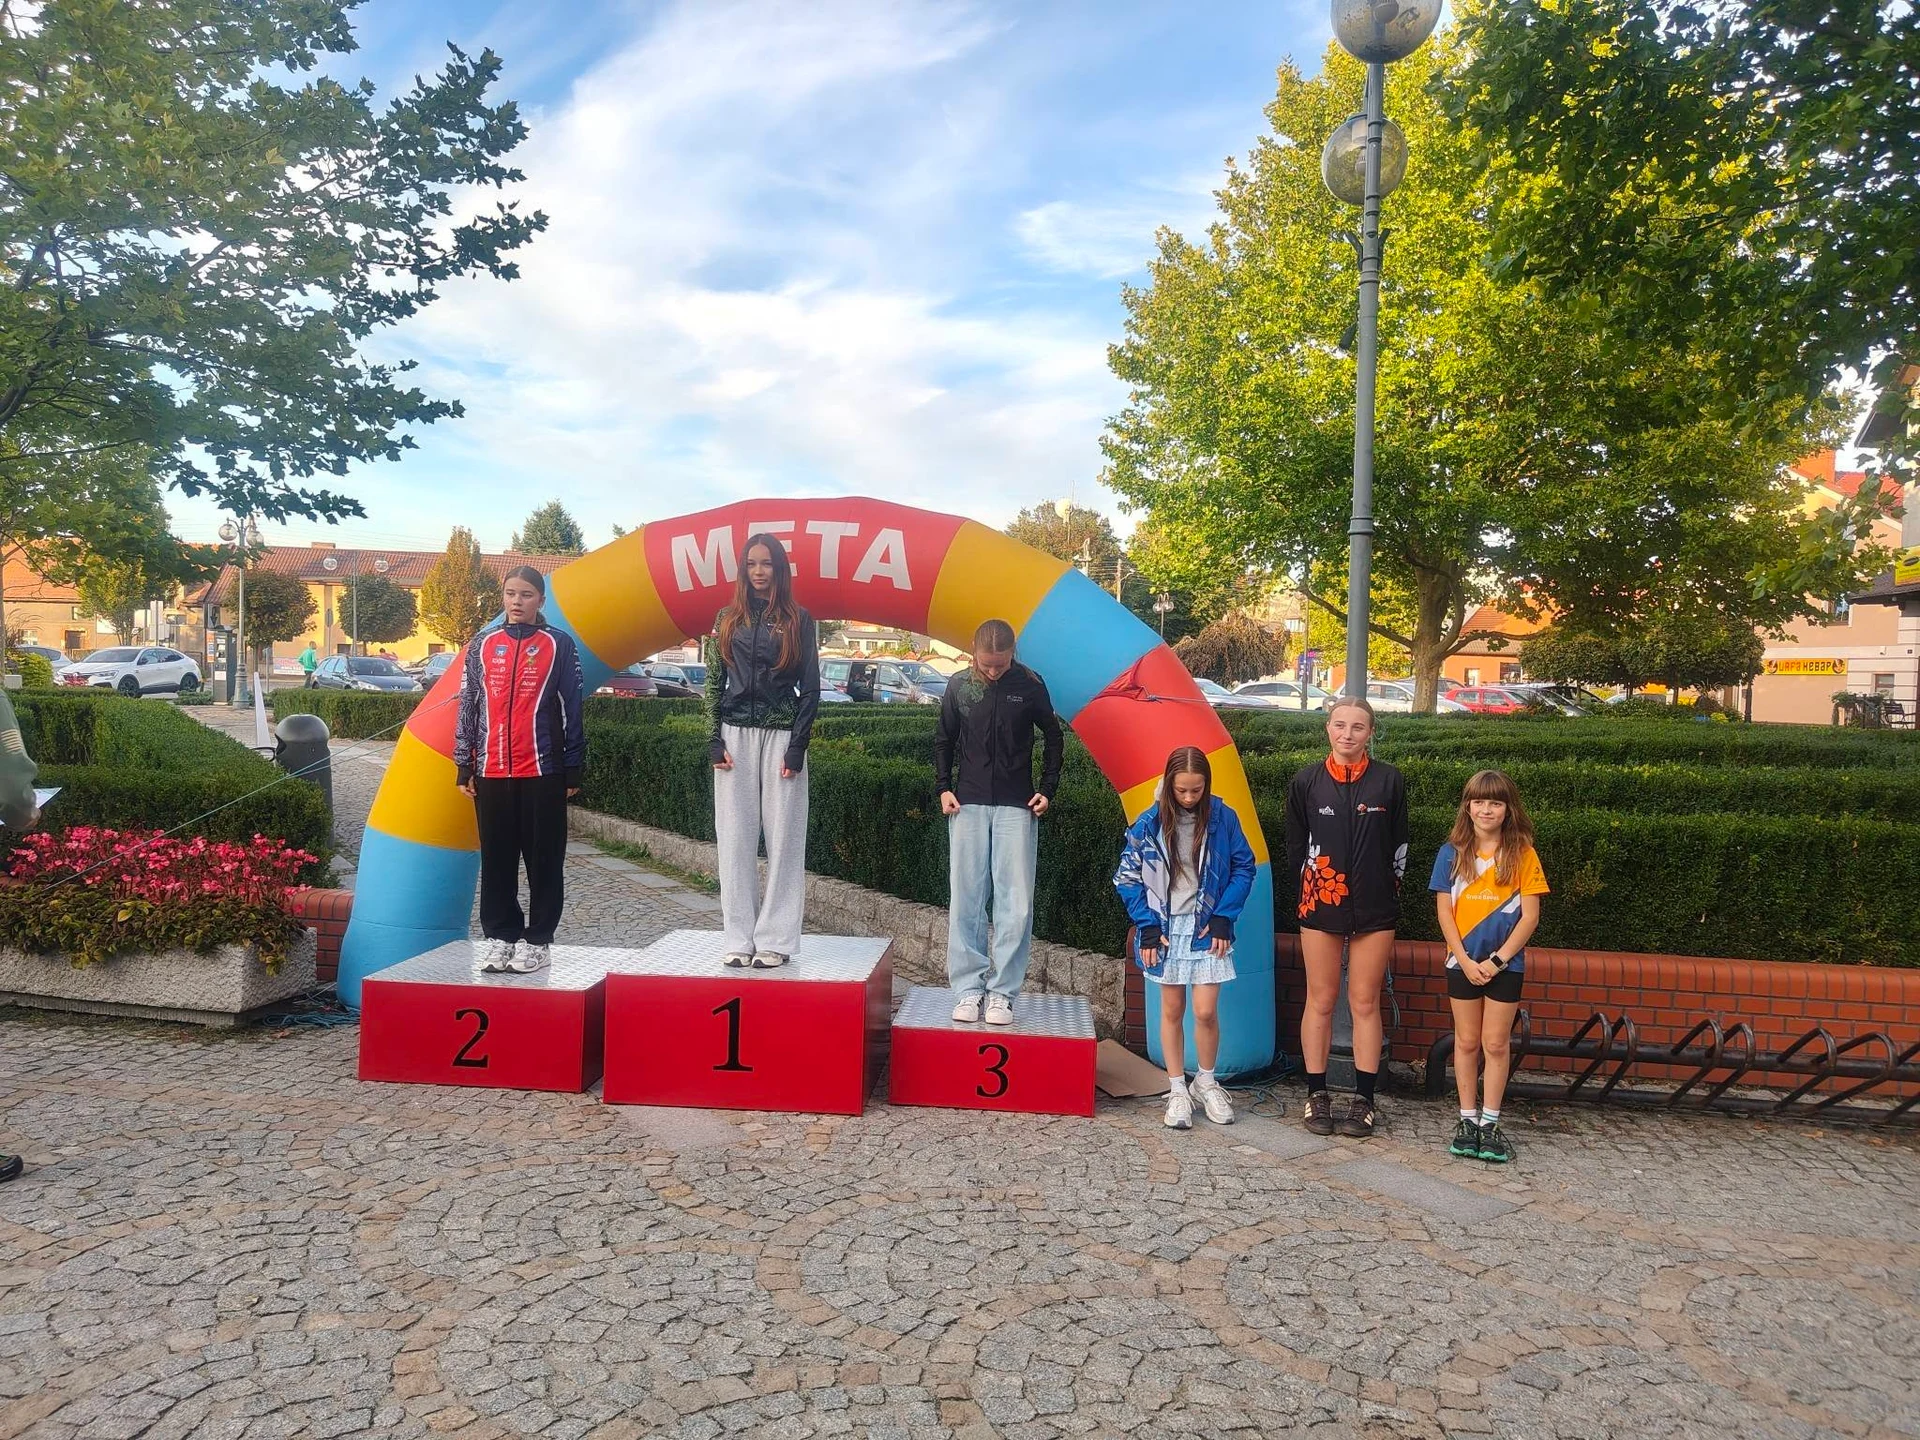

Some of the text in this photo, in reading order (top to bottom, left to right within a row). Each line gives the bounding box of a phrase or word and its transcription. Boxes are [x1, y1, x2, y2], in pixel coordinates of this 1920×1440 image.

[451, 1007, 490, 1069] 2
[712, 996, 754, 1073] 1
[976, 1043, 1010, 1098] 3
